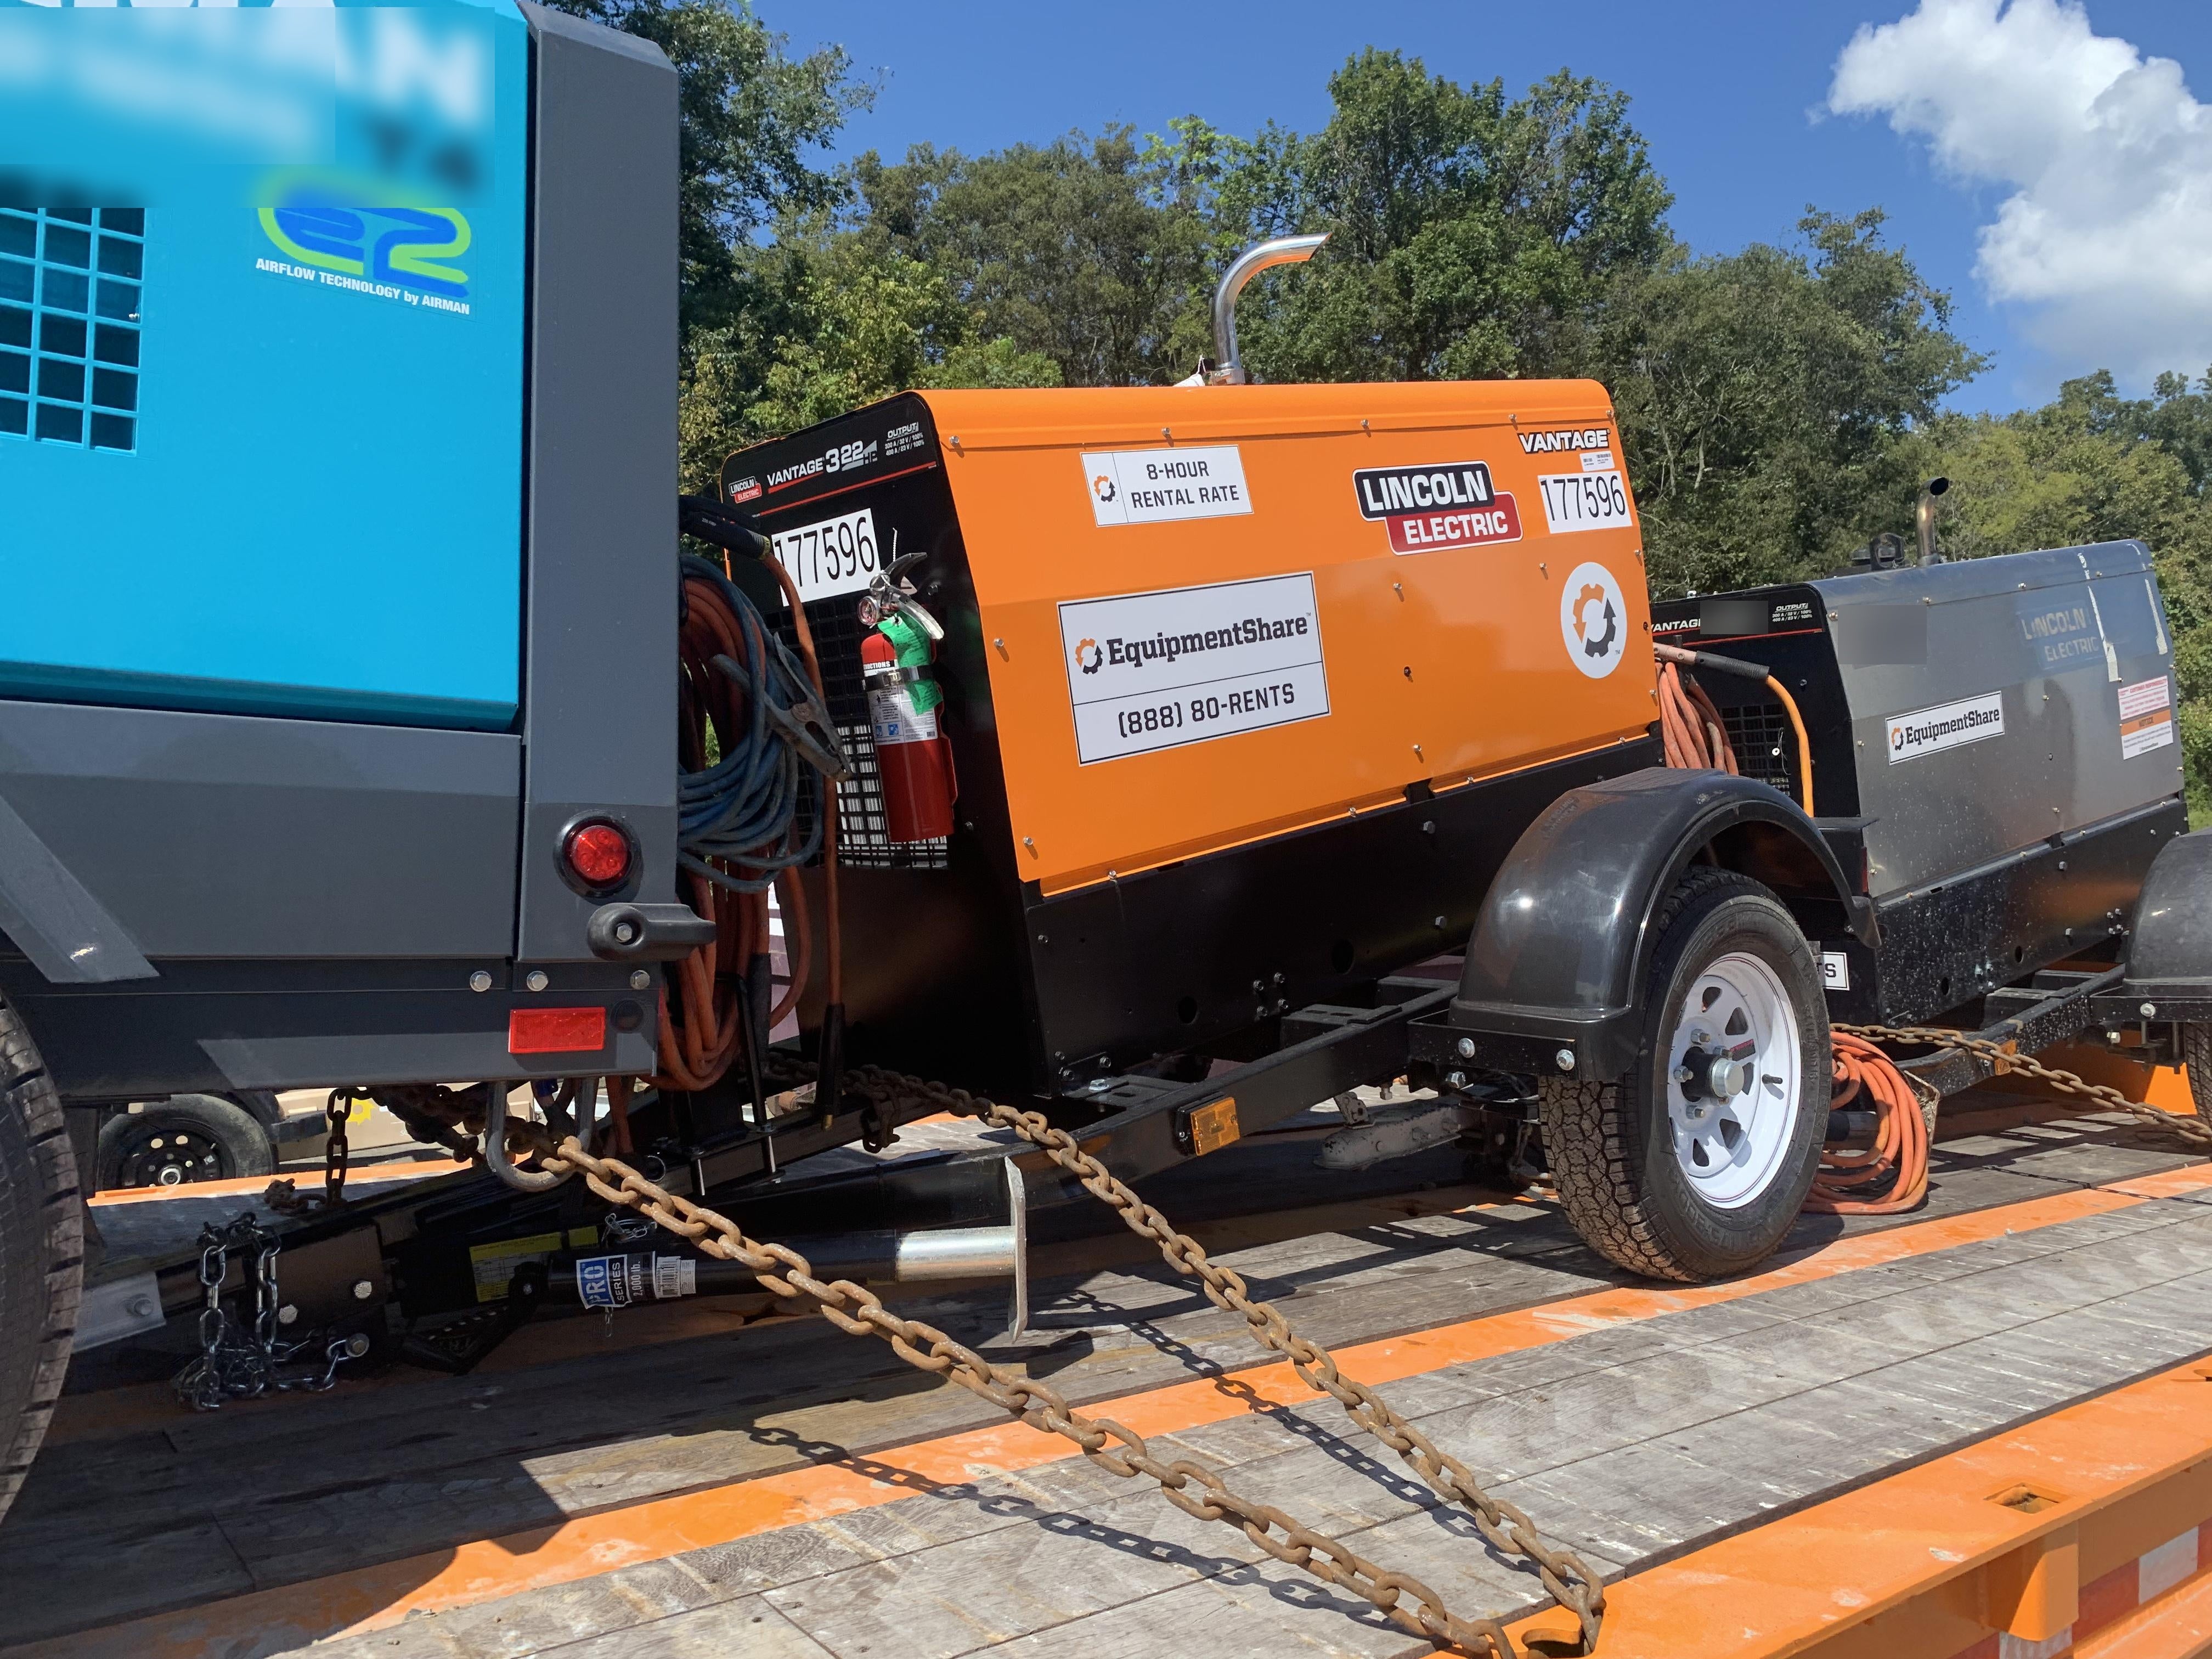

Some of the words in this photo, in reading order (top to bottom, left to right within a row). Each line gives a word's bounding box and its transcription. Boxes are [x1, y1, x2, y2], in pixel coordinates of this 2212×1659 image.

[256, 258, 315, 281] AIRFLOW
[319, 271, 401, 300] TECHNOLOGY
[404, 290, 419, 306] by
[421, 295, 470, 315] AIRMAN
[887, 422, 917, 439] OUTPUT
[1519, 430, 1609, 453] VANTAGE
[767, 458, 823, 486] VANTAGE
[1146, 460, 1210, 480] 8-HOUR
[730, 478, 755, 494] LINCOLN
[737, 488, 759, 500] ELECTRIC
[1131, 488, 1195, 509] RENTAL
[1198, 484, 1240, 504] RATE
[1363, 470, 1488, 512] LINCOLN
[1540, 475, 1626, 522] 177596
[1403, 511, 1509, 545] ELECTRIC
[774, 516, 875, 588] 177596
[1776, 602, 1807, 611] OUTPUT
[1651, 618, 1701, 633] ANTAG
[2021, 608, 2087, 640] LINCOLN
[1106, 616, 1308, 668] EquipmentShare
[2044, 636, 2098, 662] ELECTRIC
[1118, 702, 1183, 738] (888)
[1191, 682, 1295, 724] 80-RENTS
[1905, 709, 2000, 745] EquipmentShare
[630, 1261, 641, 1273] lb.
[584, 1264, 610, 1304] PRO
[612, 1262, 625, 1301] SERIES
[631, 1277, 644, 1296] 2,000
